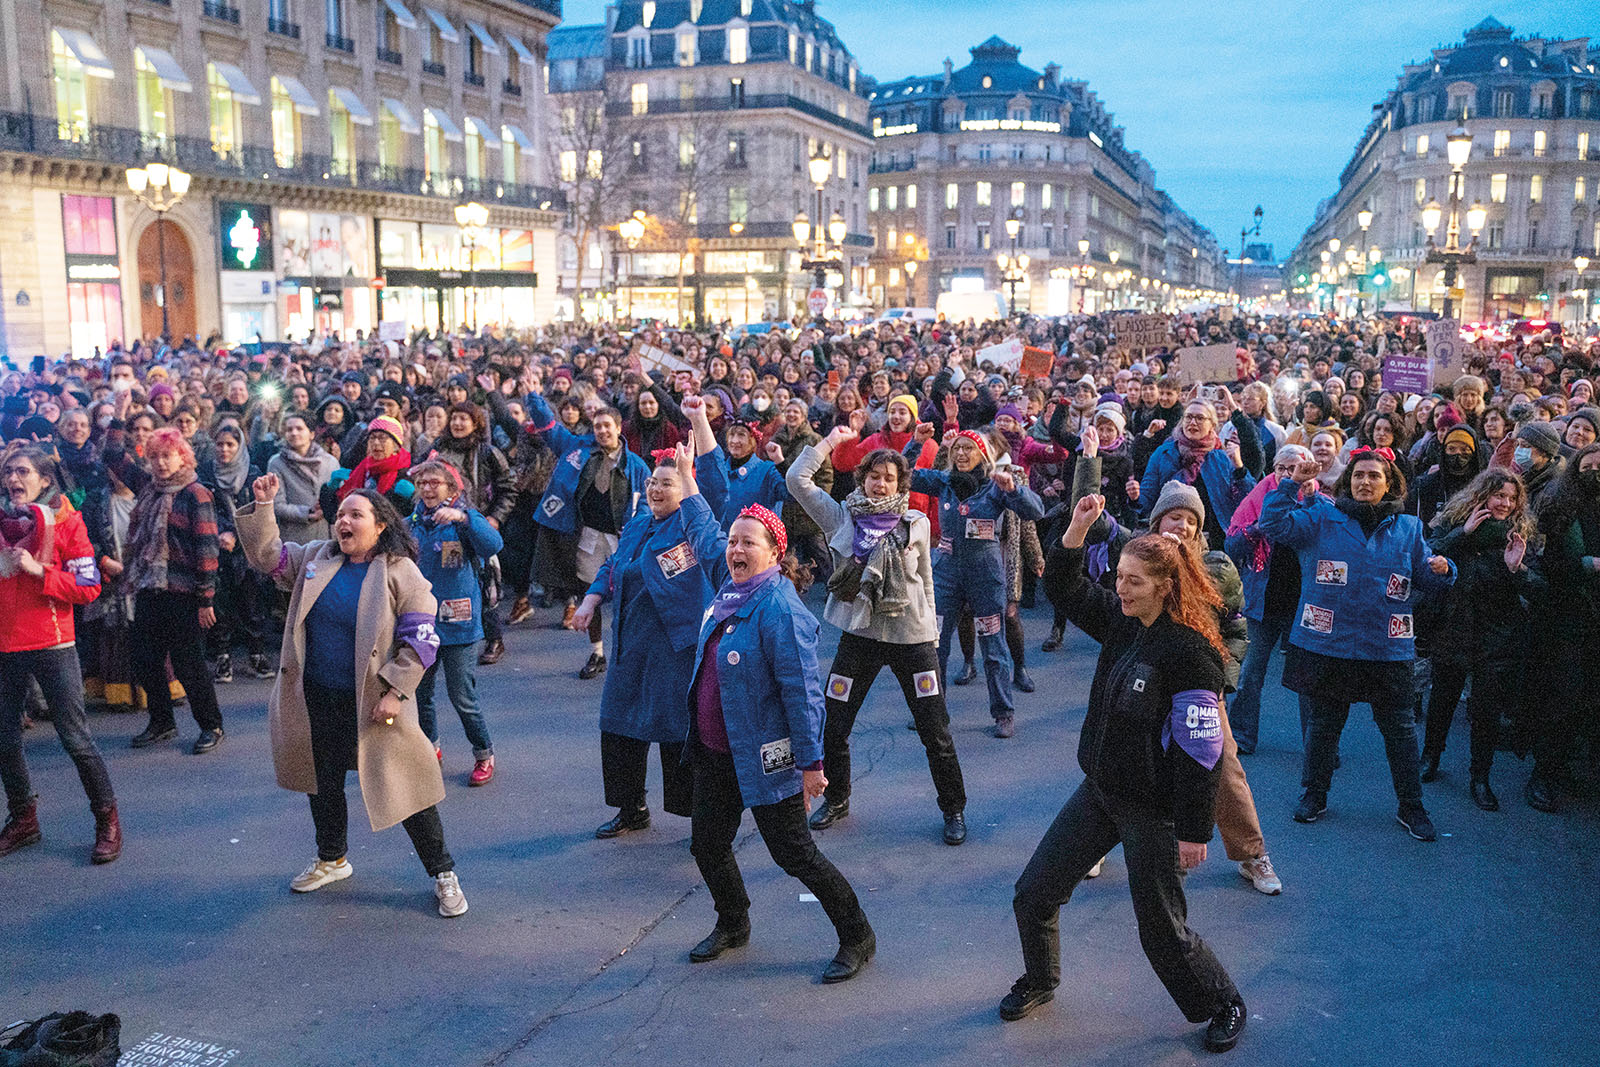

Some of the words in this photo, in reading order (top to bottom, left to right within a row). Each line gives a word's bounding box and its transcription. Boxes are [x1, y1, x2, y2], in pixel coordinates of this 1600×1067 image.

[1117, 317, 1166, 333] LAISSEZ-
[1428, 321, 1456, 332] AFRO
[1432, 332, 1453, 342] FEM
[1186, 704, 1199, 728] 8
[131, 1041, 202, 1063] MONDE
